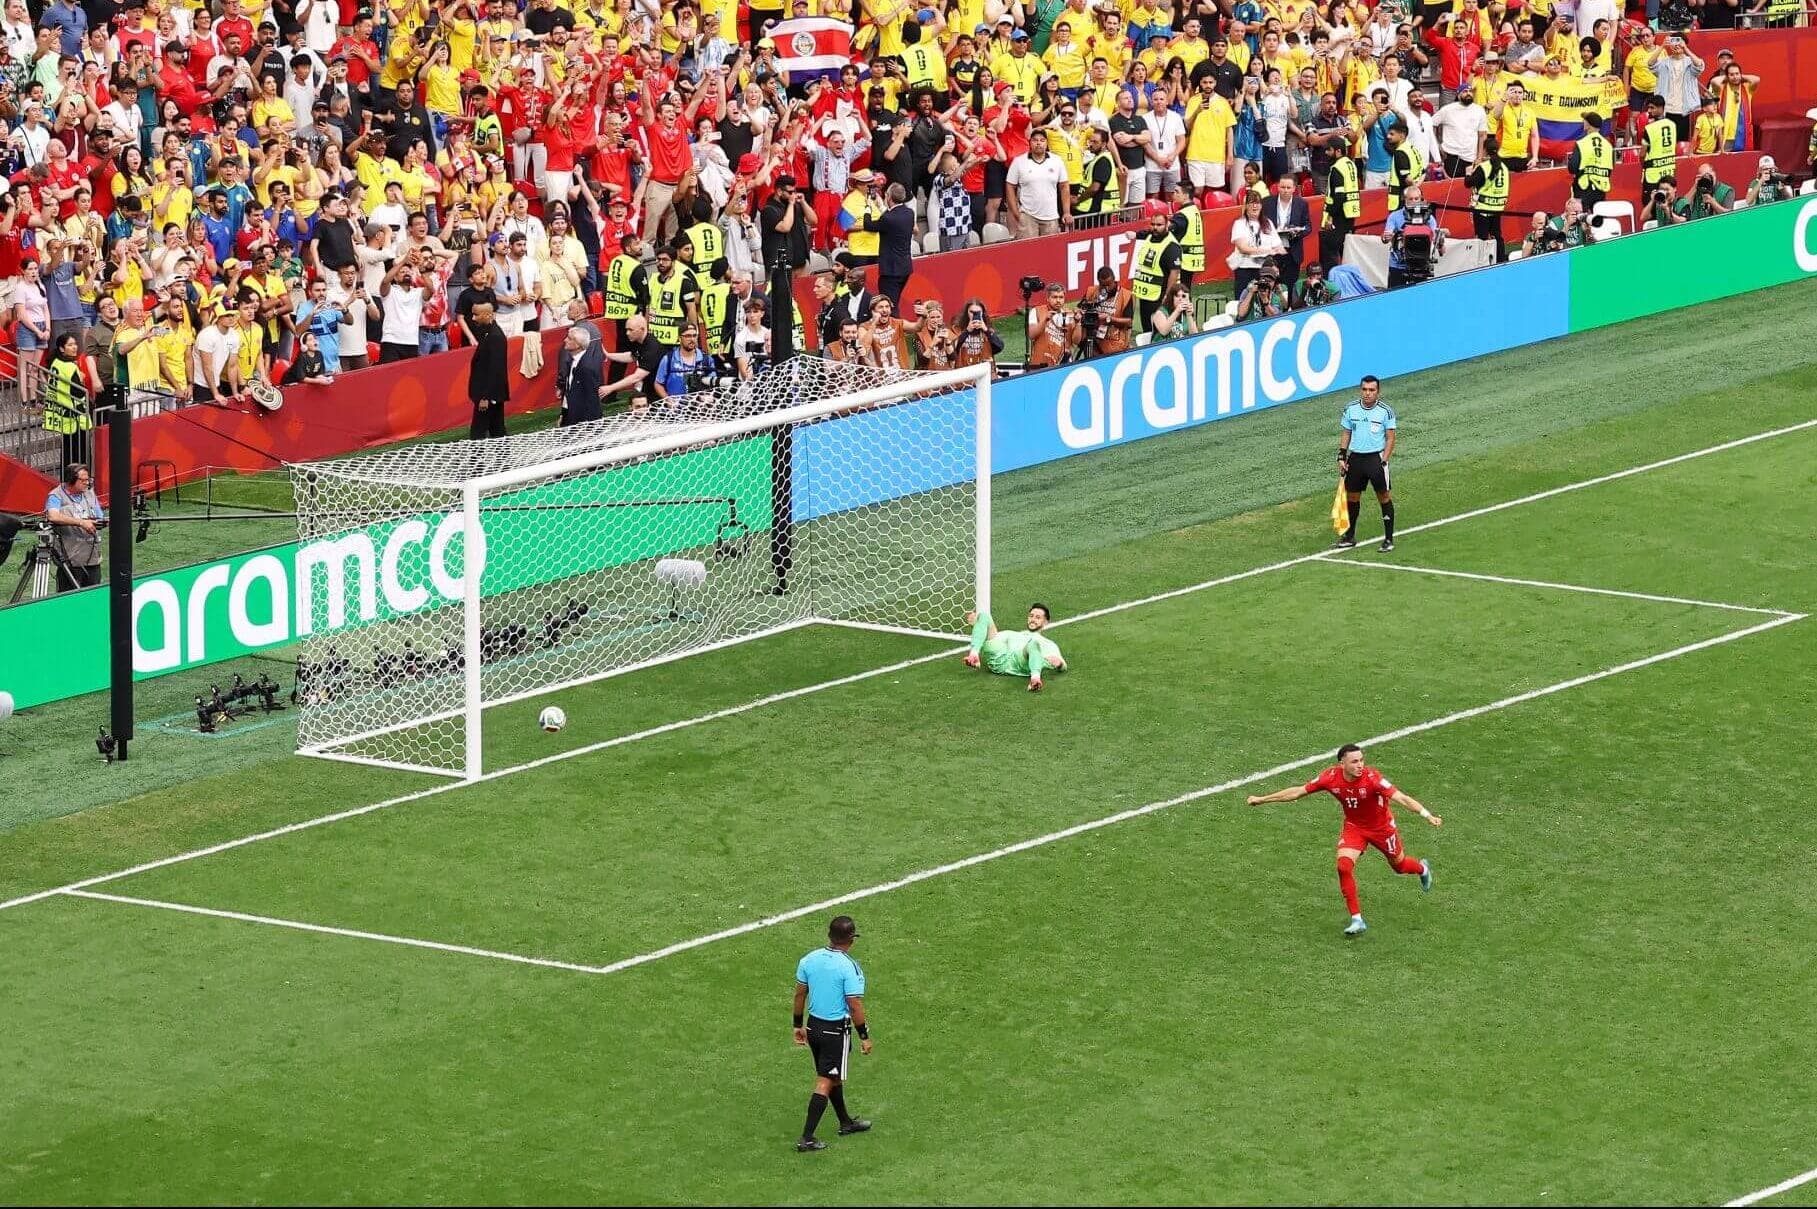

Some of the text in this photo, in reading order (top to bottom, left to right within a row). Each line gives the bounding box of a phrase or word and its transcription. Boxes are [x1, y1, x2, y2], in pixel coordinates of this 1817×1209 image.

[1543, 94, 1554, 105] DE
[1559, 95, 1599, 108] DAVINSON
[1056, 311, 1343, 449] aramco
[131, 511, 487, 673] aramco
